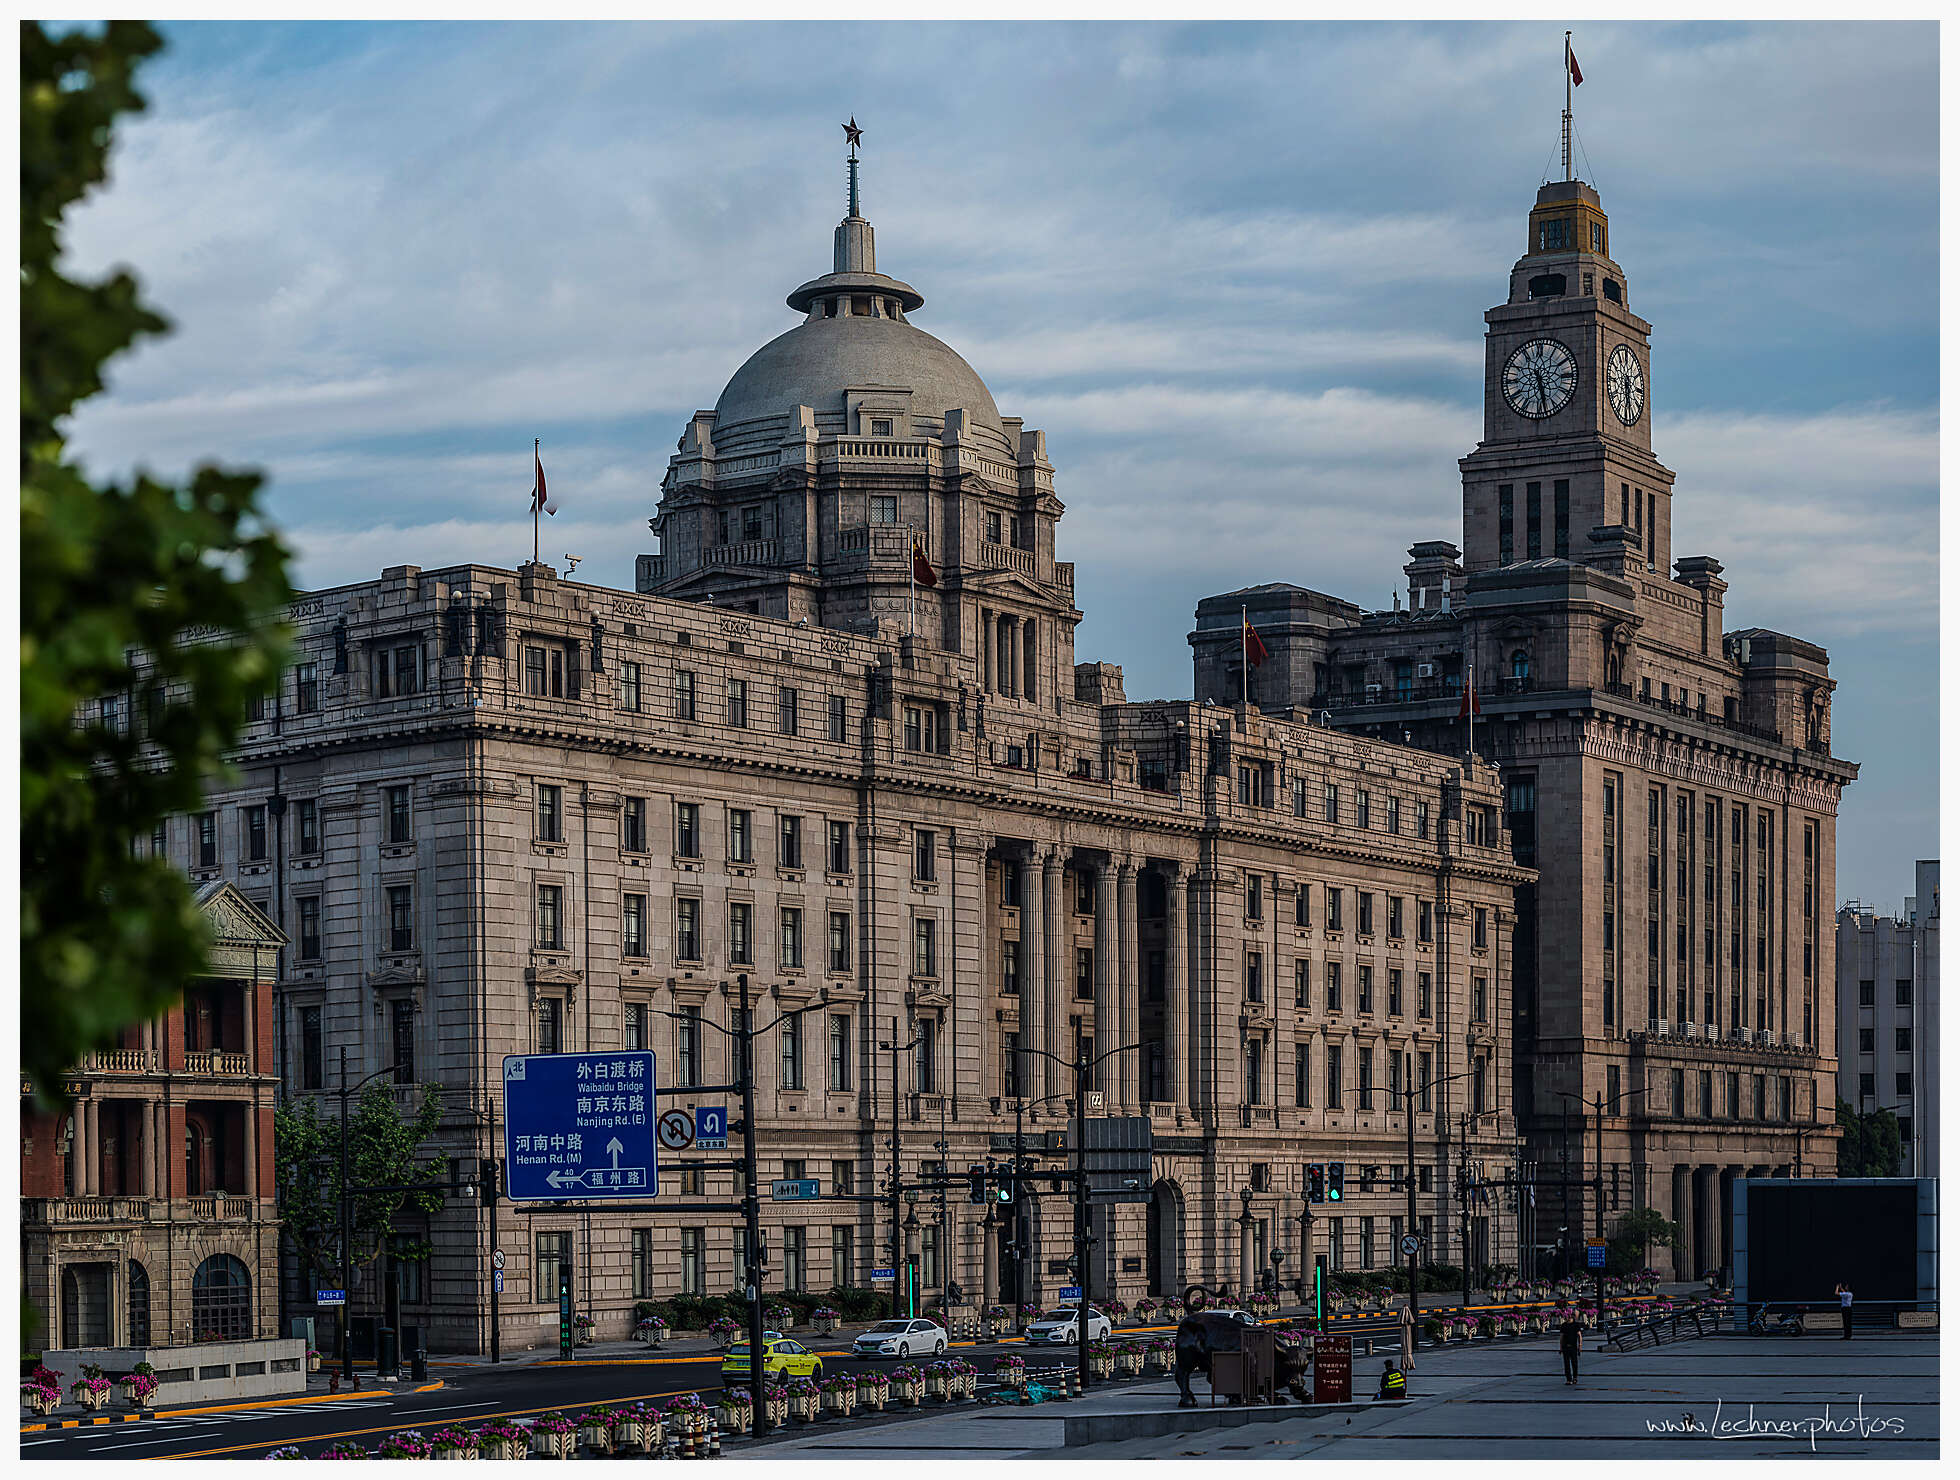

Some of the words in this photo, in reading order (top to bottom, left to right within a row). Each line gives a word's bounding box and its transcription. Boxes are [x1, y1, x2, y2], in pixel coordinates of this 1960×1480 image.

[513, 1061, 523, 1073] 北
[576, 1060, 645, 1080] 外白渡桥
[578, 1083, 615, 1093] Waibaidu
[617, 1081, 644, 1093] Bridge
[576, 1095, 645, 1114] 南京东路
[576, 1117, 613, 1128] Nanjing
[516, 1133, 583, 1152] 河南中路
[516, 1155, 547, 1165] Henan
[564, 1168, 574, 1176] 40
[592, 1171, 640, 1185] 福州路
[565, 1182, 574, 1190] 17
